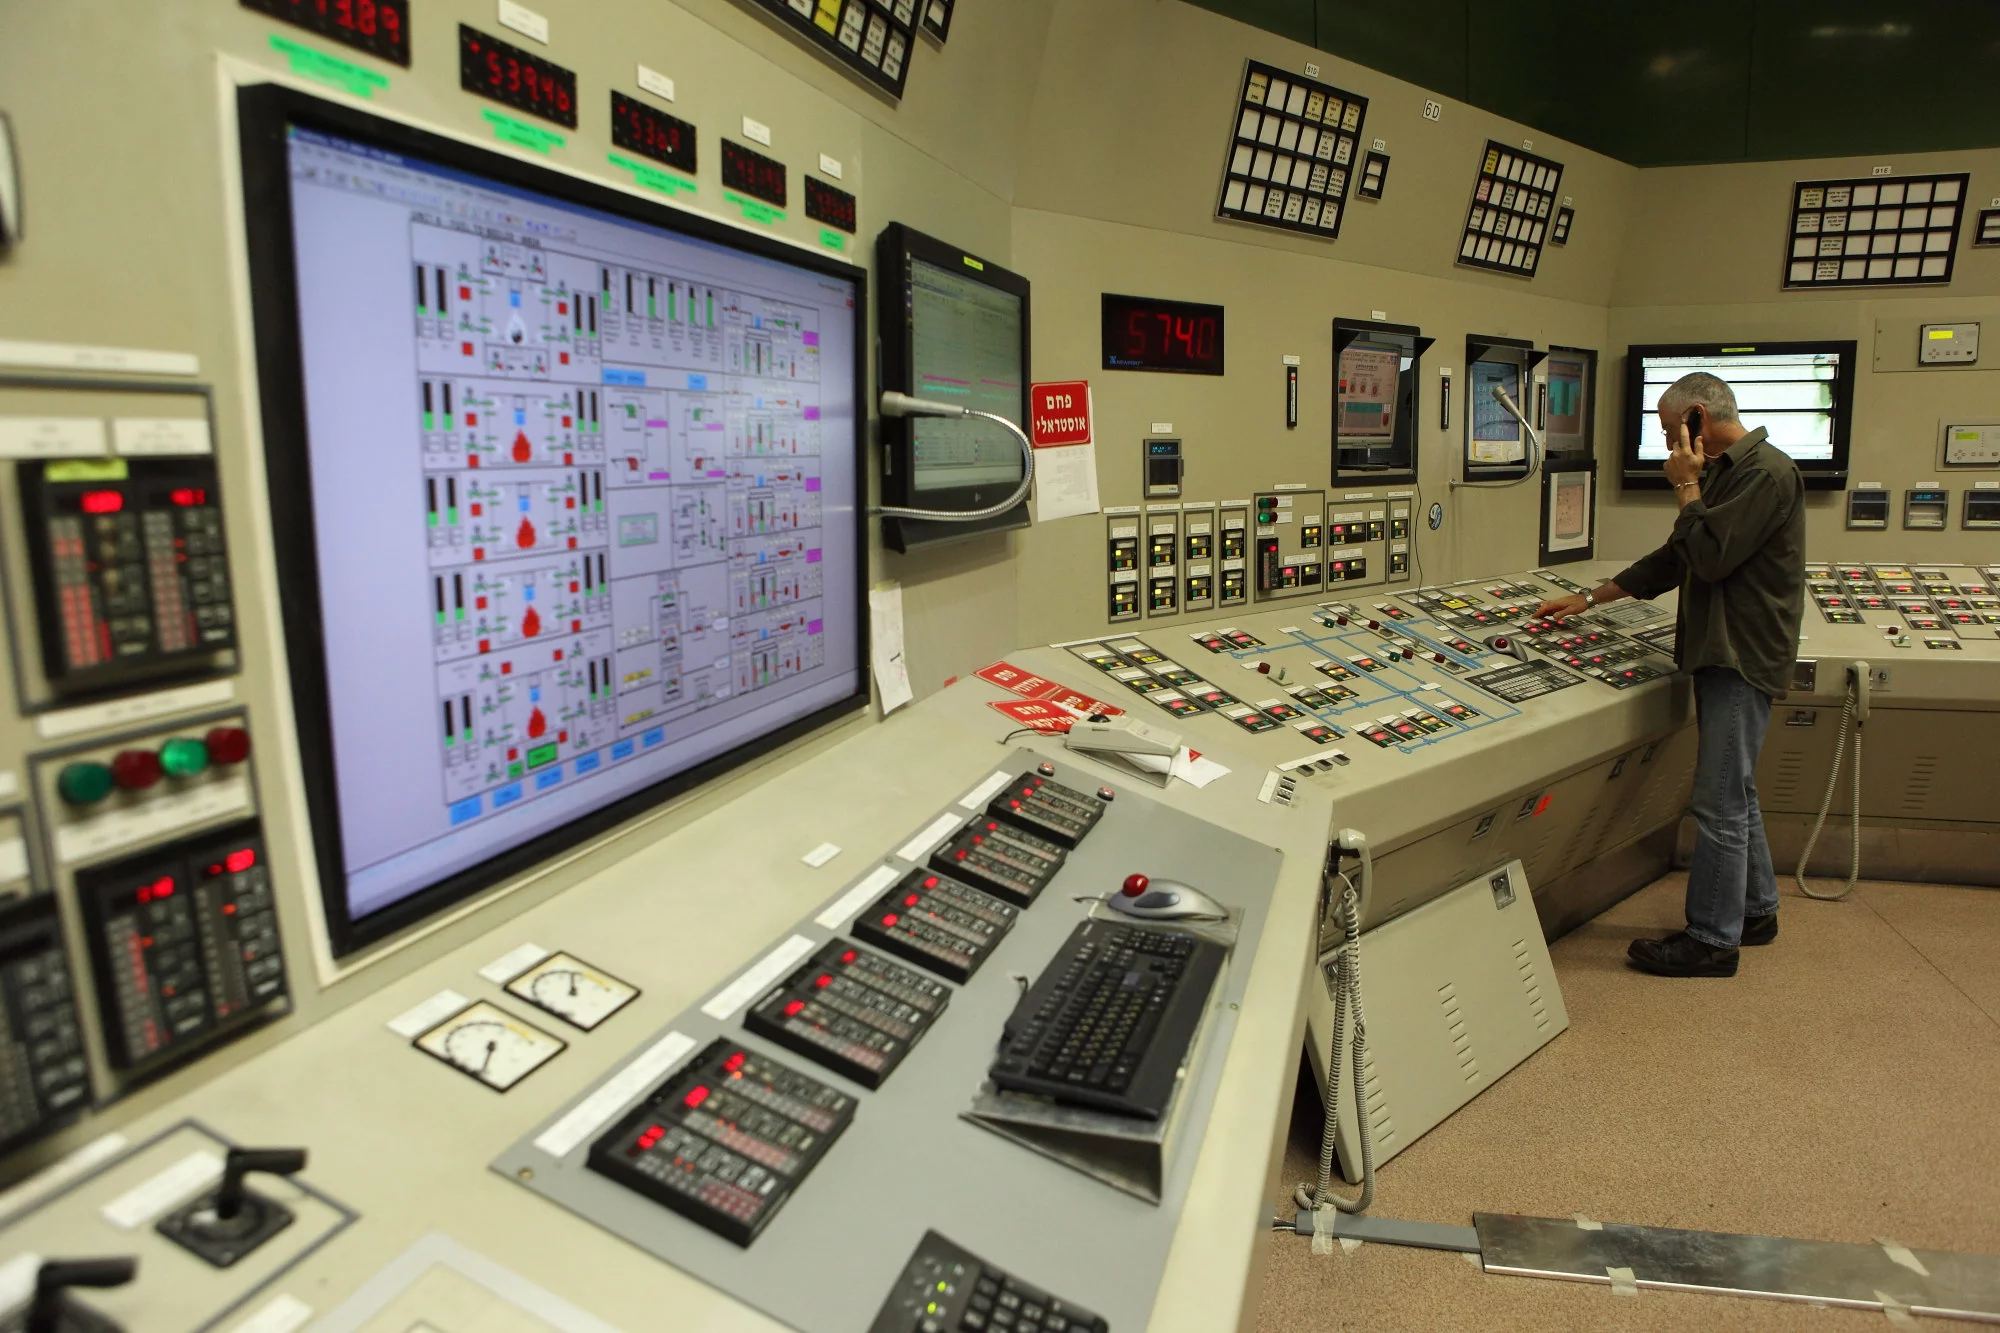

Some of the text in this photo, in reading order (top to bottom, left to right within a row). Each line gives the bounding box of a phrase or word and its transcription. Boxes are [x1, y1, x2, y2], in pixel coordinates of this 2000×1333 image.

[1425, 102, 1440, 119] 6D
[1046, 394, 1072, 410] פחם
[1036, 415, 1086, 434] אוסטראלי
[1014, 705, 1048, 715] פחם
